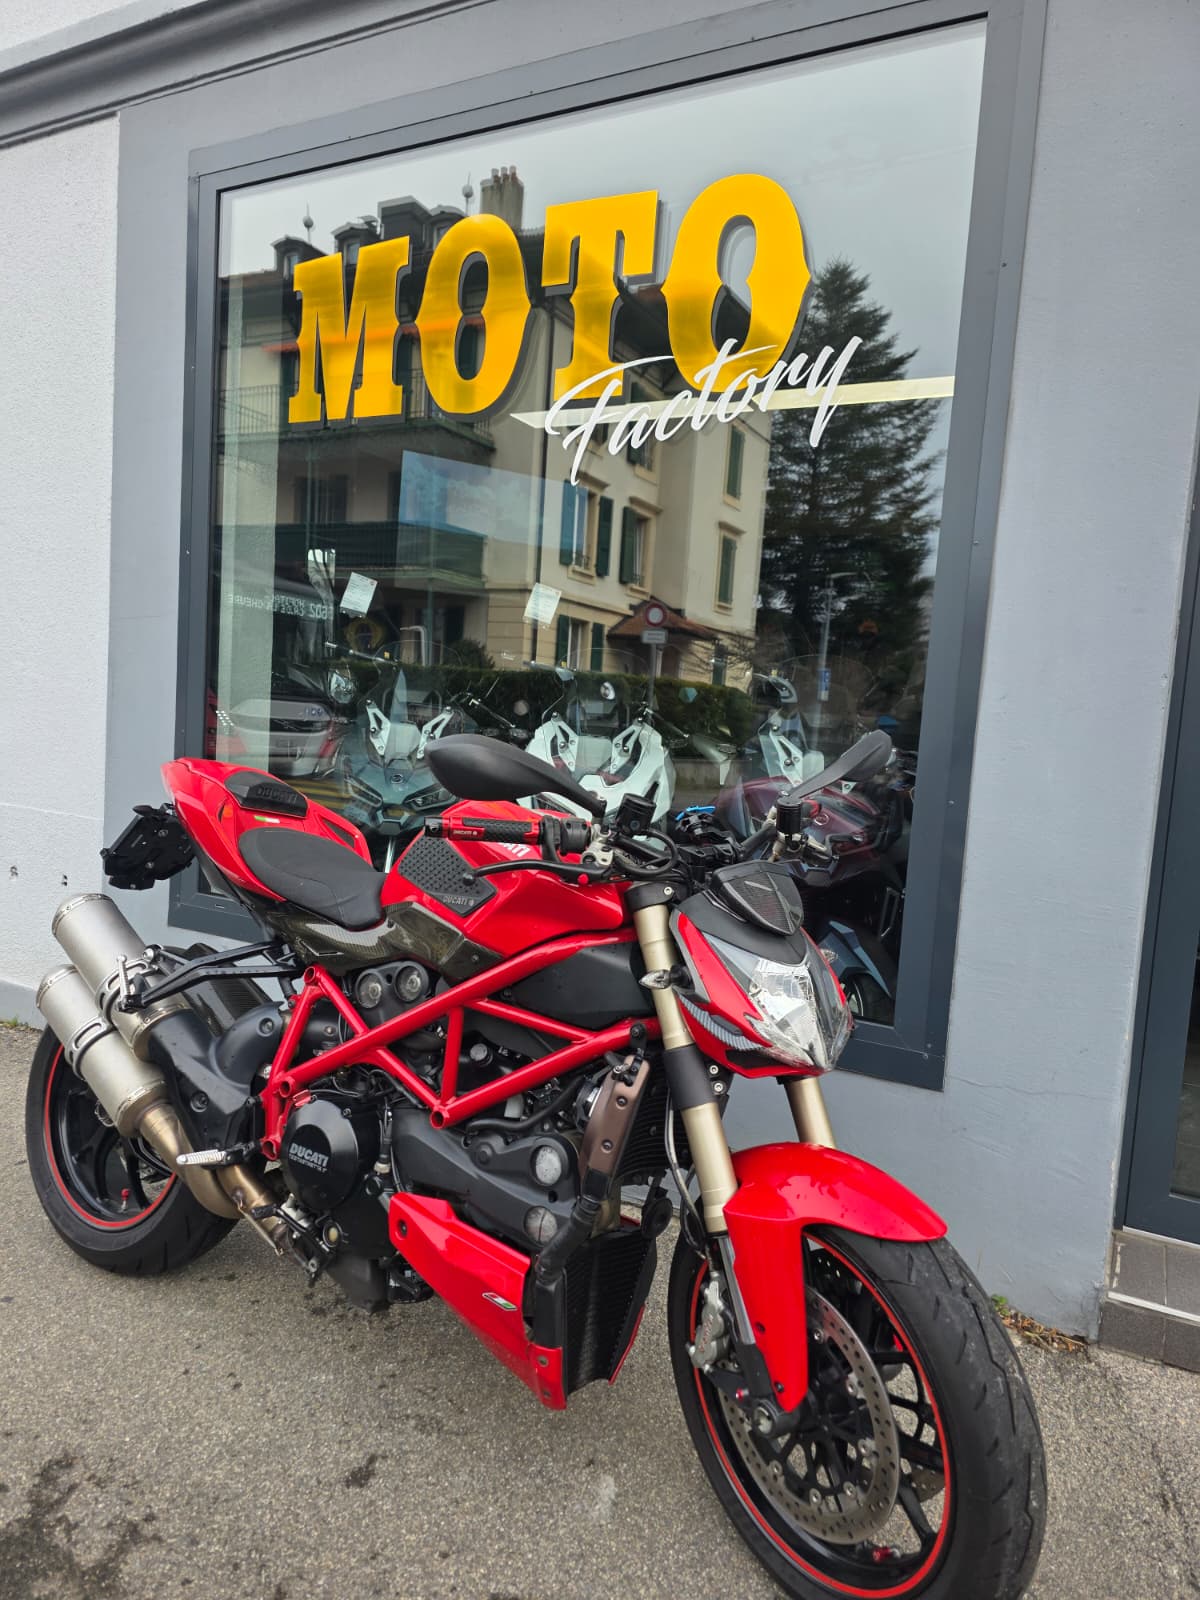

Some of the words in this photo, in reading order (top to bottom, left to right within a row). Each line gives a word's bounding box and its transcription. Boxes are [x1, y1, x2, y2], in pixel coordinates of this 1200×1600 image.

[289, 173, 811, 424] MOTO
[544, 335, 864, 486] Factory
[289, 1142, 329, 1168] DUCATI
